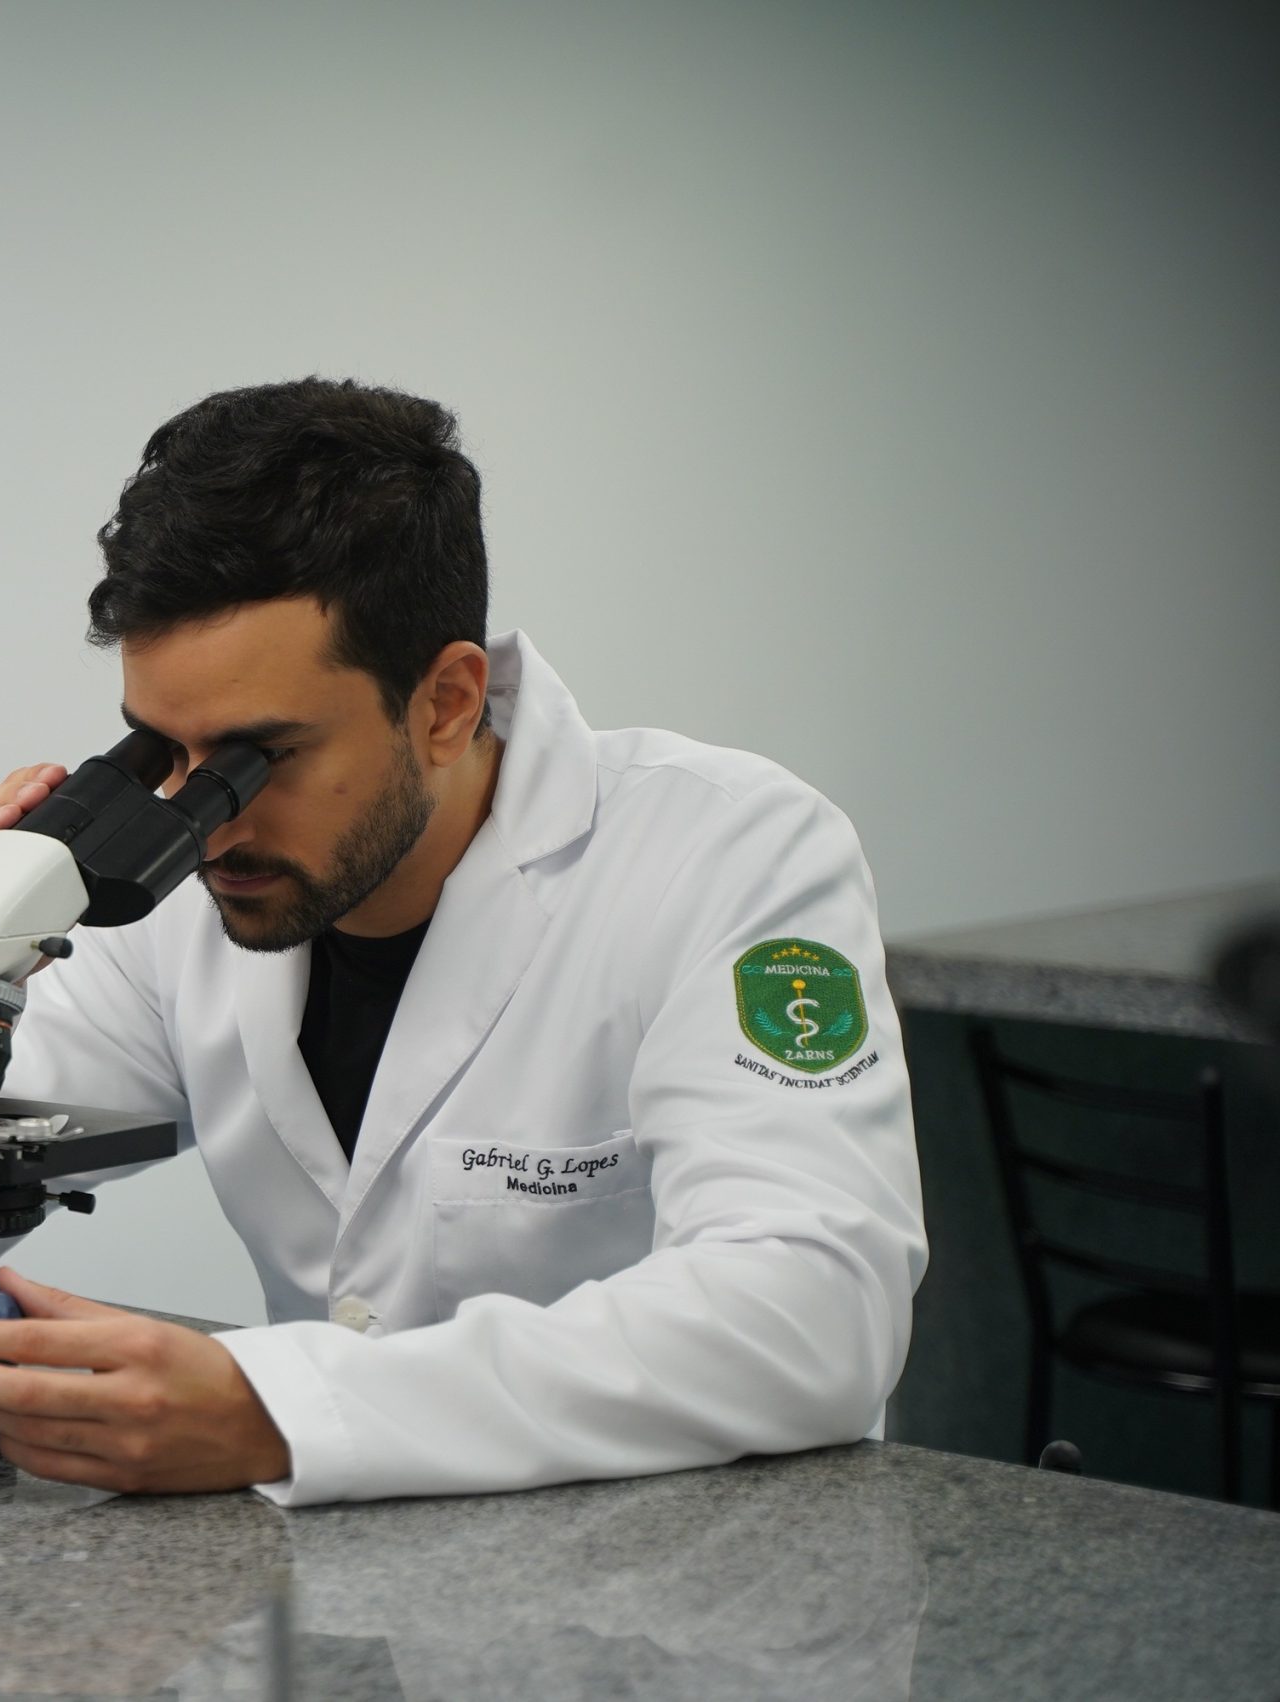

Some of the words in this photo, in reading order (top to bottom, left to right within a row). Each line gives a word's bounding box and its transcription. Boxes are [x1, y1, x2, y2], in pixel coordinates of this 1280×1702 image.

[764, 964, 831, 977] MEDICINA
[784, 1049, 835, 1061] ZARNS
[734, 1053, 778, 1081] SANITAS
[778, 1074, 833, 1089] INCIDAT
[462, 1147, 529, 1172] Gabriel
[537, 1159, 555, 1180] G.
[561, 1153, 619, 1178] Lopes
[507, 1175, 578, 1195] Medicina
